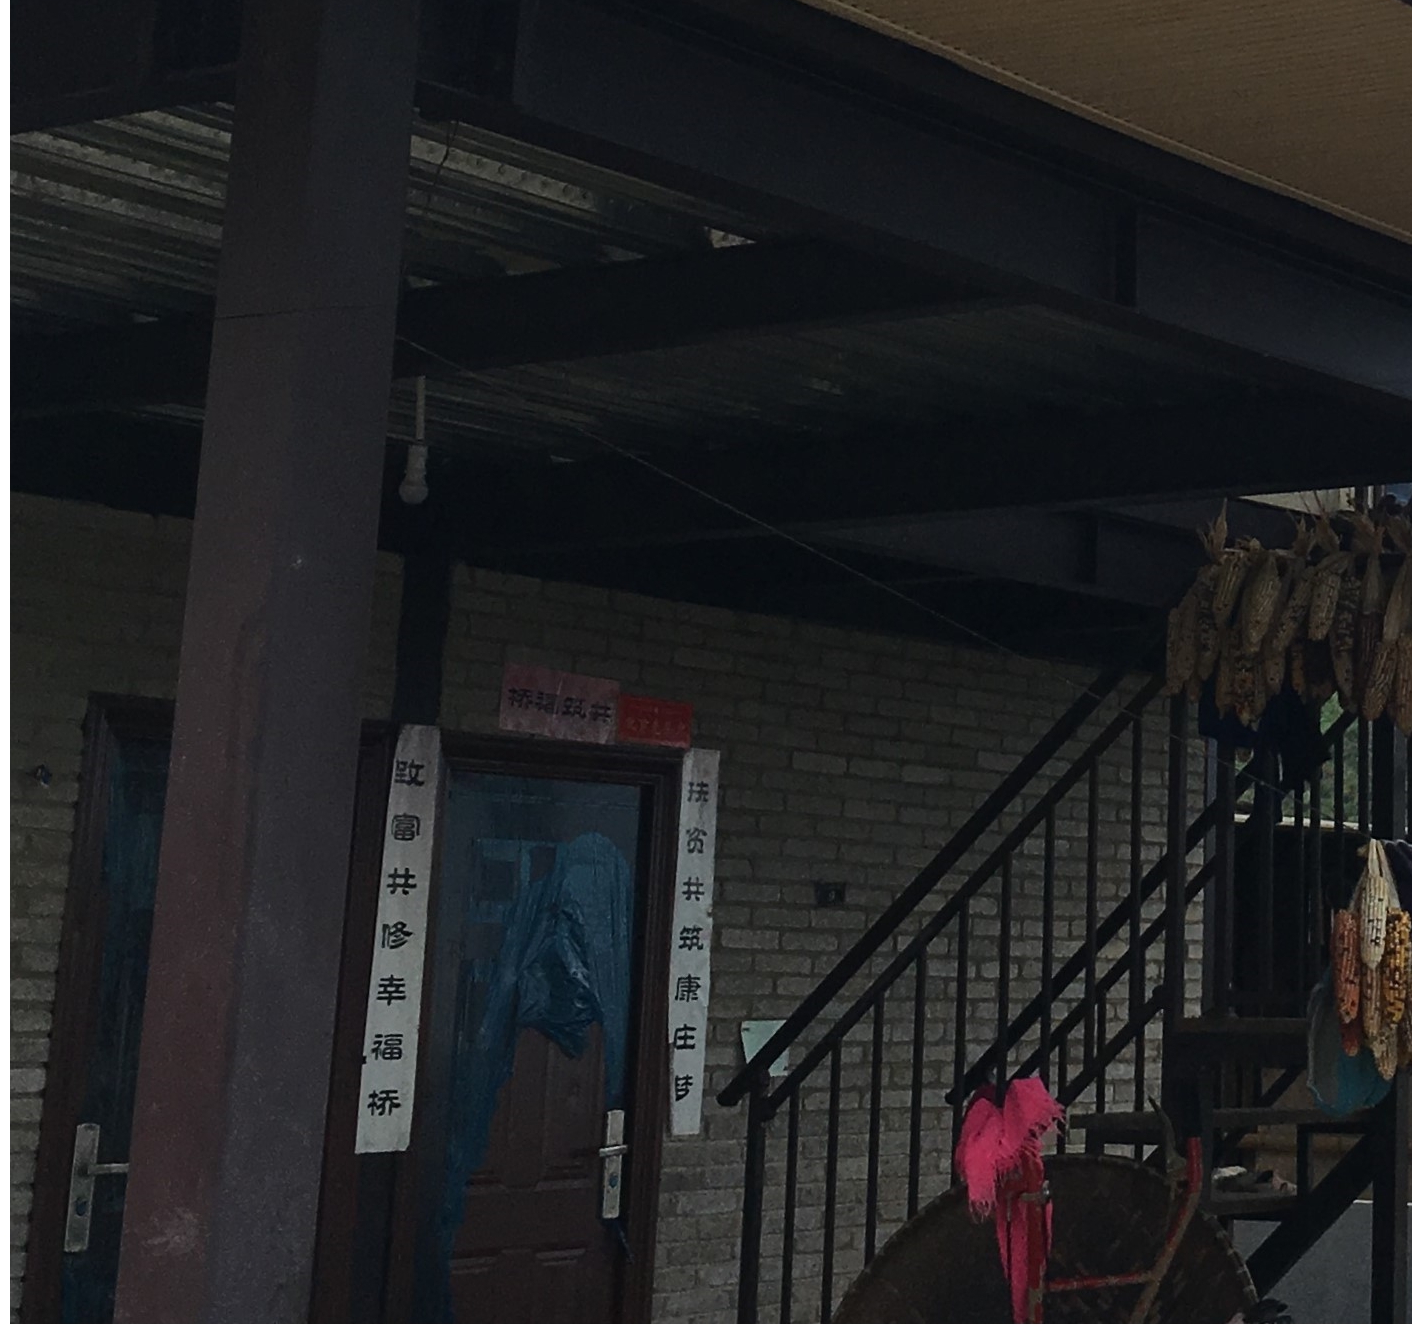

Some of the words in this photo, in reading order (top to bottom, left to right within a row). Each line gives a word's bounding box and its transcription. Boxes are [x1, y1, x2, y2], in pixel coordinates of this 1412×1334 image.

[367, 759, 425, 1117] 致富共修幸福桥
